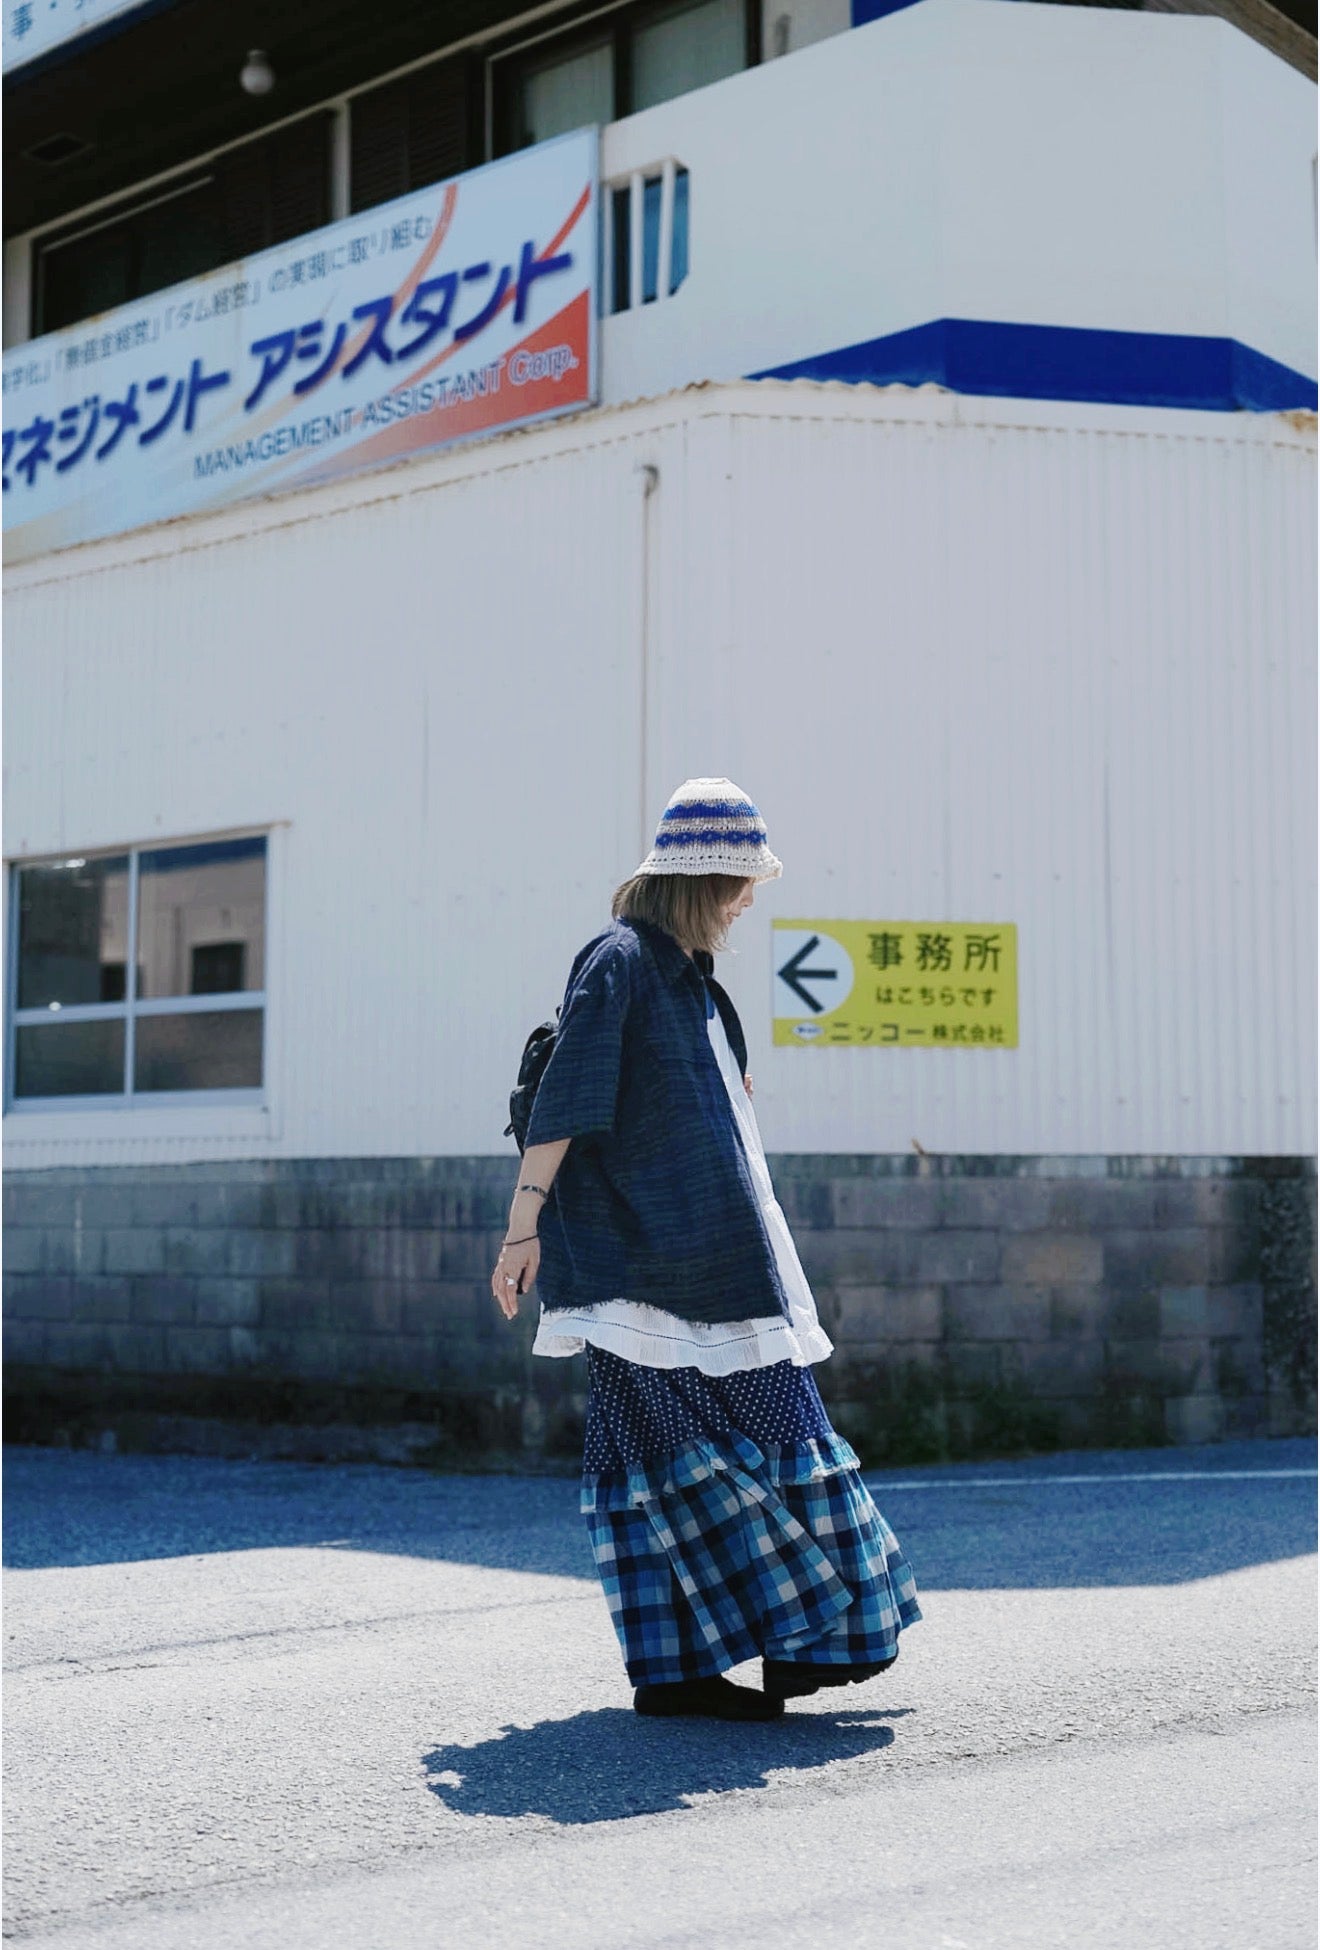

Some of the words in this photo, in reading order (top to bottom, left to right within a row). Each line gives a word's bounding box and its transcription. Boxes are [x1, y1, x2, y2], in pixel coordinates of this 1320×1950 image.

[244, 240, 572, 411] アシスタント
[194, 407, 353, 477] MANAGEMENT
[362, 357, 504, 430] ASSISTANT
[509, 345, 578, 384] Corp.
[867, 932, 1001, 972] 事務所
[876, 986, 997, 1007] はこちらです
